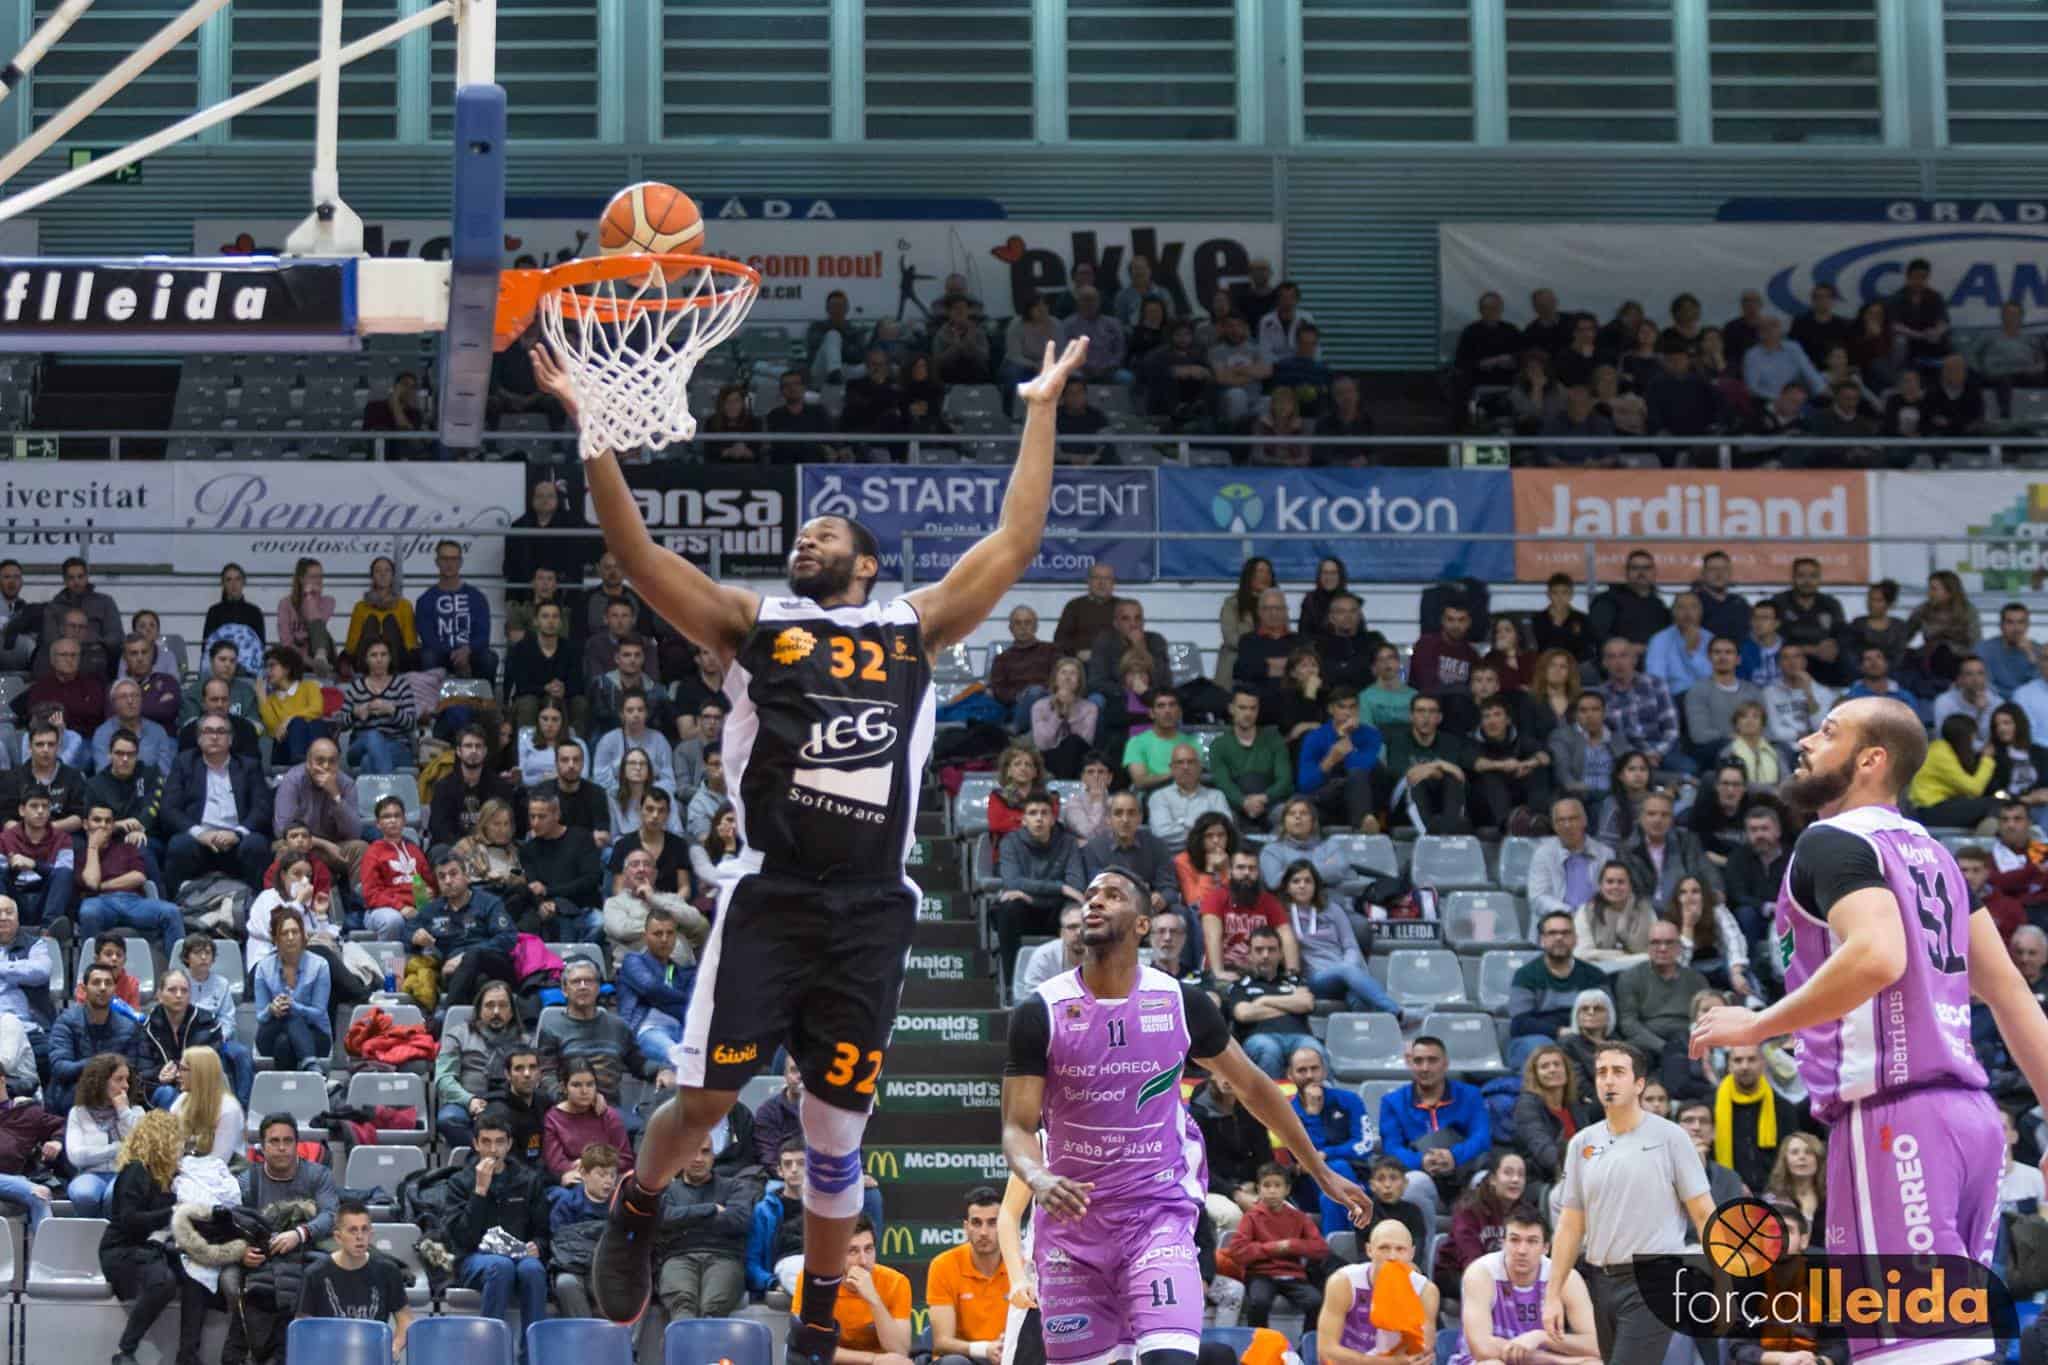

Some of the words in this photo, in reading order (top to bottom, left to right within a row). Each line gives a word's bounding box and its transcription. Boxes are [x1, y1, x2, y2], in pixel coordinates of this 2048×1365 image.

[718, 197, 836, 219] ADA
[816, 250, 883, 278] nou!
[4, 271, 268, 321] flleida
[6, 480, 148, 509] iversitat
[1277, 485, 1459, 533] kroton
[1537, 483, 1848, 538] Jardiland
[437, 594, 470, 613] GE
[828, 635, 888, 682] 32
[811, 707, 890, 755] ICG
[788, 787, 886, 825] Software
[928, 969, 964, 980] Lleida
[897, 1015, 979, 1031] Donald's
[942, 1028, 980, 1041] Lleida
[1107, 1018, 1128, 1048] 11
[824, 1041, 884, 1095] 32
[1101, 1060, 1161, 1076] HORECA
[886, 1081, 1000, 1098] McDonald's
[962, 1096, 1000, 1108] Lleida
[1150, 1276, 1178, 1307] 11
